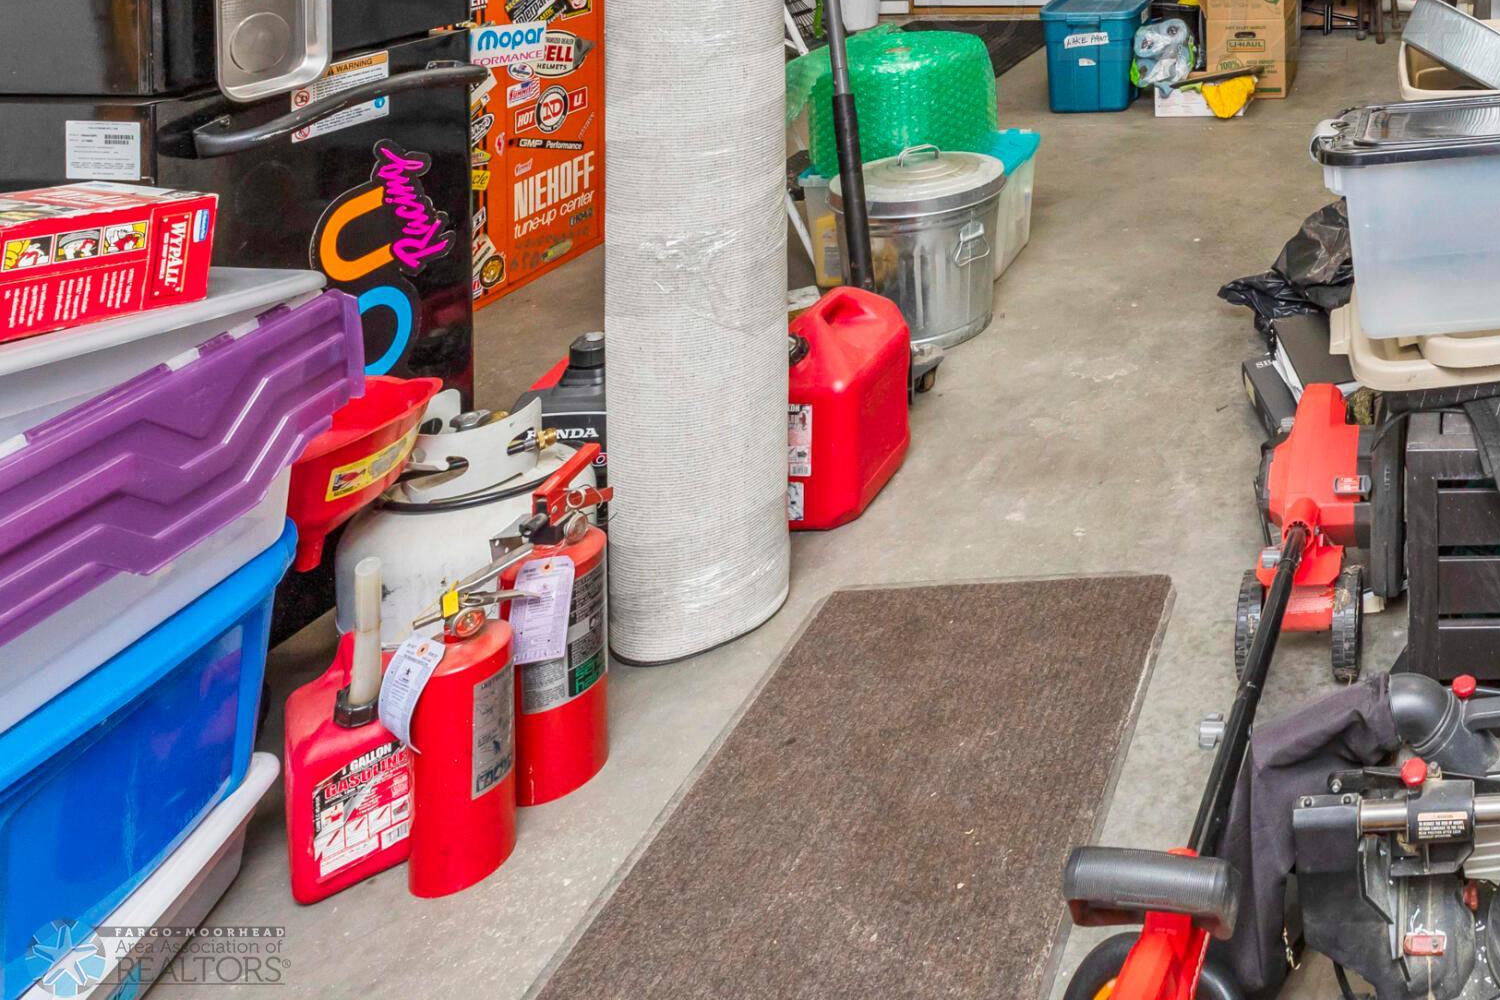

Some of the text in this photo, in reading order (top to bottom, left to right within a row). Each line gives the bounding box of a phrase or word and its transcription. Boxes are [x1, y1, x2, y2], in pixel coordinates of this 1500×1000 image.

[477, 27, 545, 51] Mopar
[1229, 40, 1264, 49] U-HAUL
[544, 44, 573, 62] ELL
[336, 57, 373, 73] WARNING
[537, 63, 567, 71] HELMETS
[1219, 60, 1239, 71] 100%
[517, 110, 535, 128] HOT
[519, 138, 582, 150] GMP Performance
[514, 150, 595, 222] NIEHOFF
[514, 208, 557, 239] tune-up
[560, 190, 595, 216] center
[165, 221, 187, 287] WYPALL
[525, 426, 599, 441] HNDA
[350, 742, 392, 771] GALLON
[324, 750, 408, 800] GASOLINE
